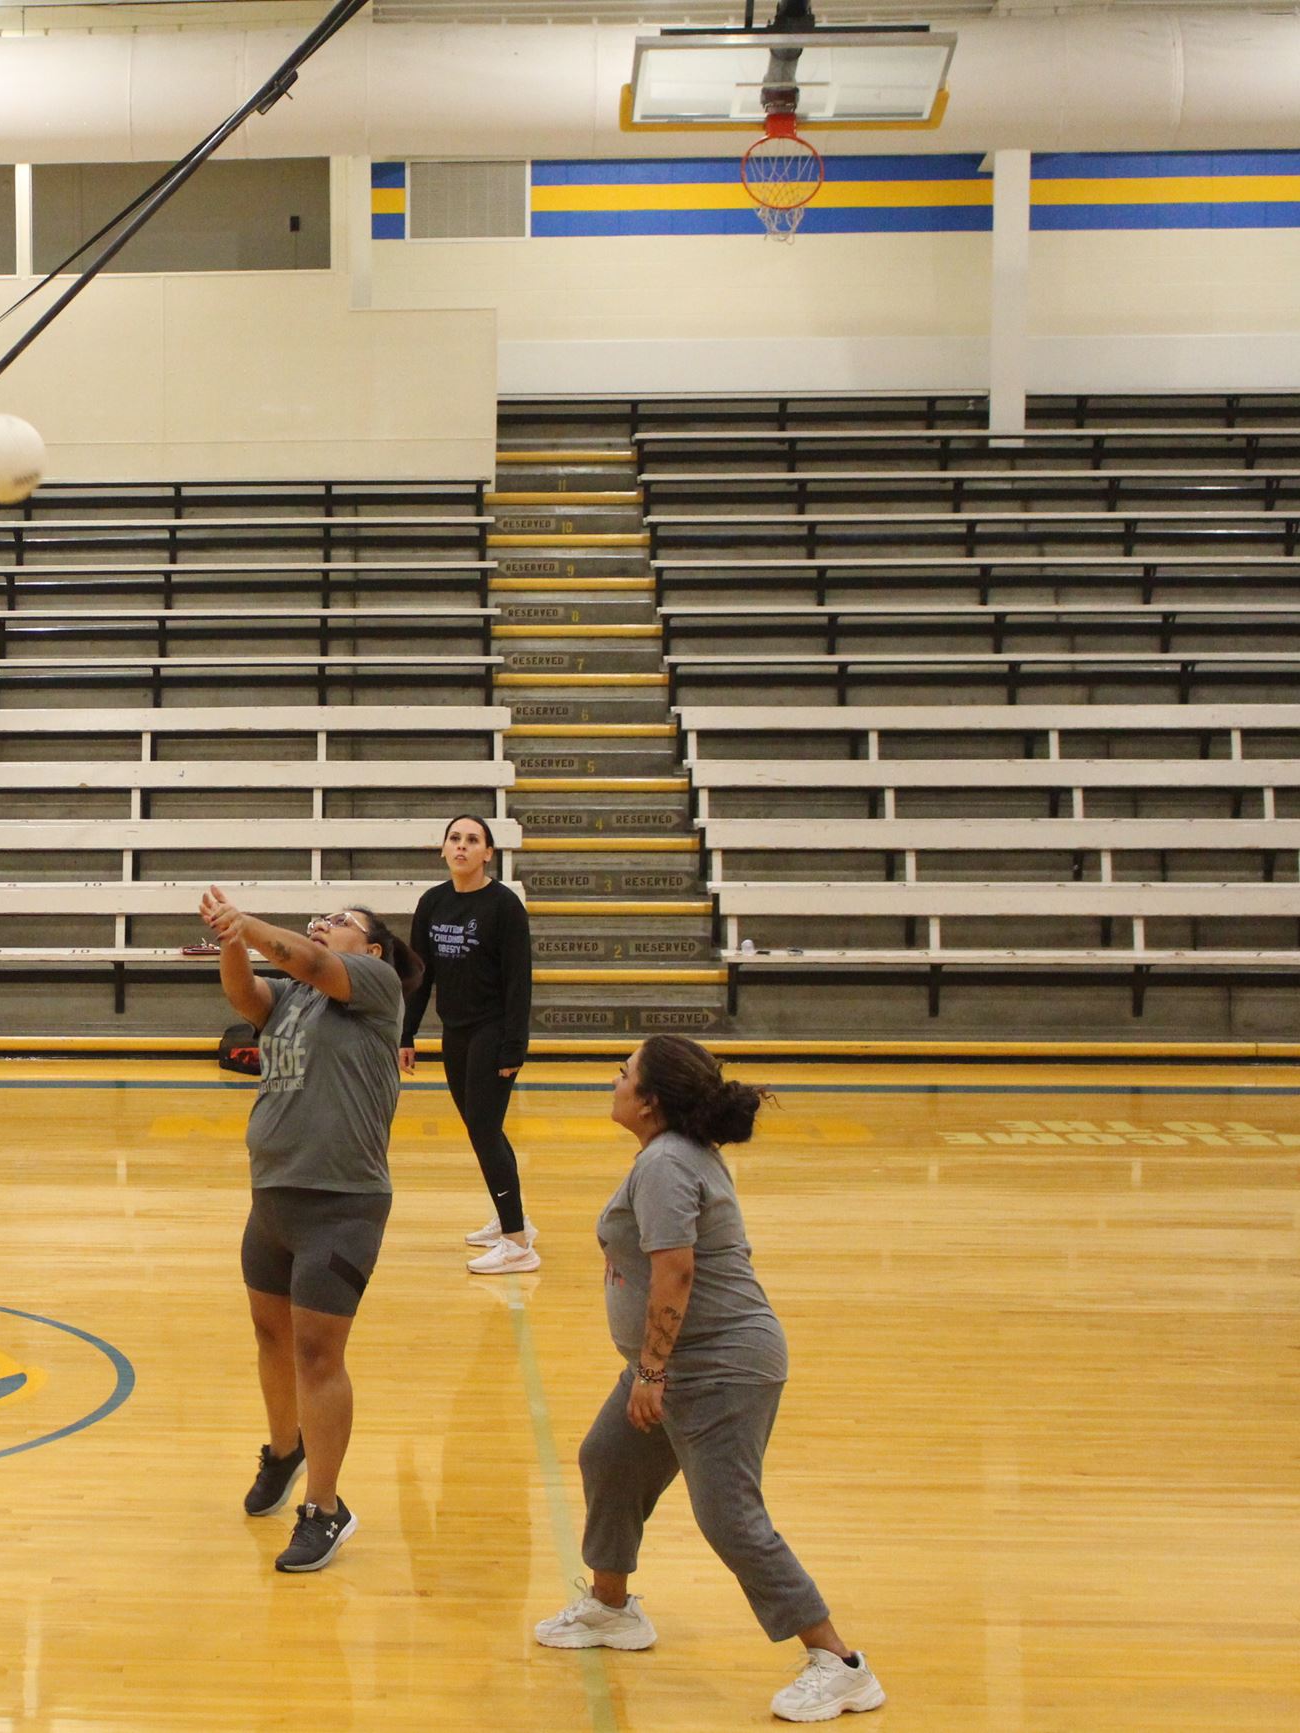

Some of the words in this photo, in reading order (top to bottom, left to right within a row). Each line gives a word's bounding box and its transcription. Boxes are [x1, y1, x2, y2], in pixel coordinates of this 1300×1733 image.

[502, 520, 550, 529] RESERVED
[562, 522, 573, 533] 10
[506, 564, 555, 572] RESERVED
[567, 565, 574, 576] 9
[508, 608, 558, 617] RESERVED
[512, 657, 564, 665] RESERVED
[577, 658, 584, 671] 7
[516, 707, 568, 715] RESERVED
[581, 710, 588, 721] 6
[520, 759, 574, 768] RESERVED
[526, 815, 582, 824] RESERVED
[615, 815, 672, 824] RESERVED
[531, 877, 589, 886] RESERVED
[604, 879, 612, 892] 3
[625, 877, 683, 886] RESERVED
[538, 942, 598, 952] RESERVED
[614, 945, 622, 958] 2
[635, 942, 695, 952] RESERVED
[544, 1013, 607, 1023] RESERVED
[646, 1013, 709, 1024] RESERVED
